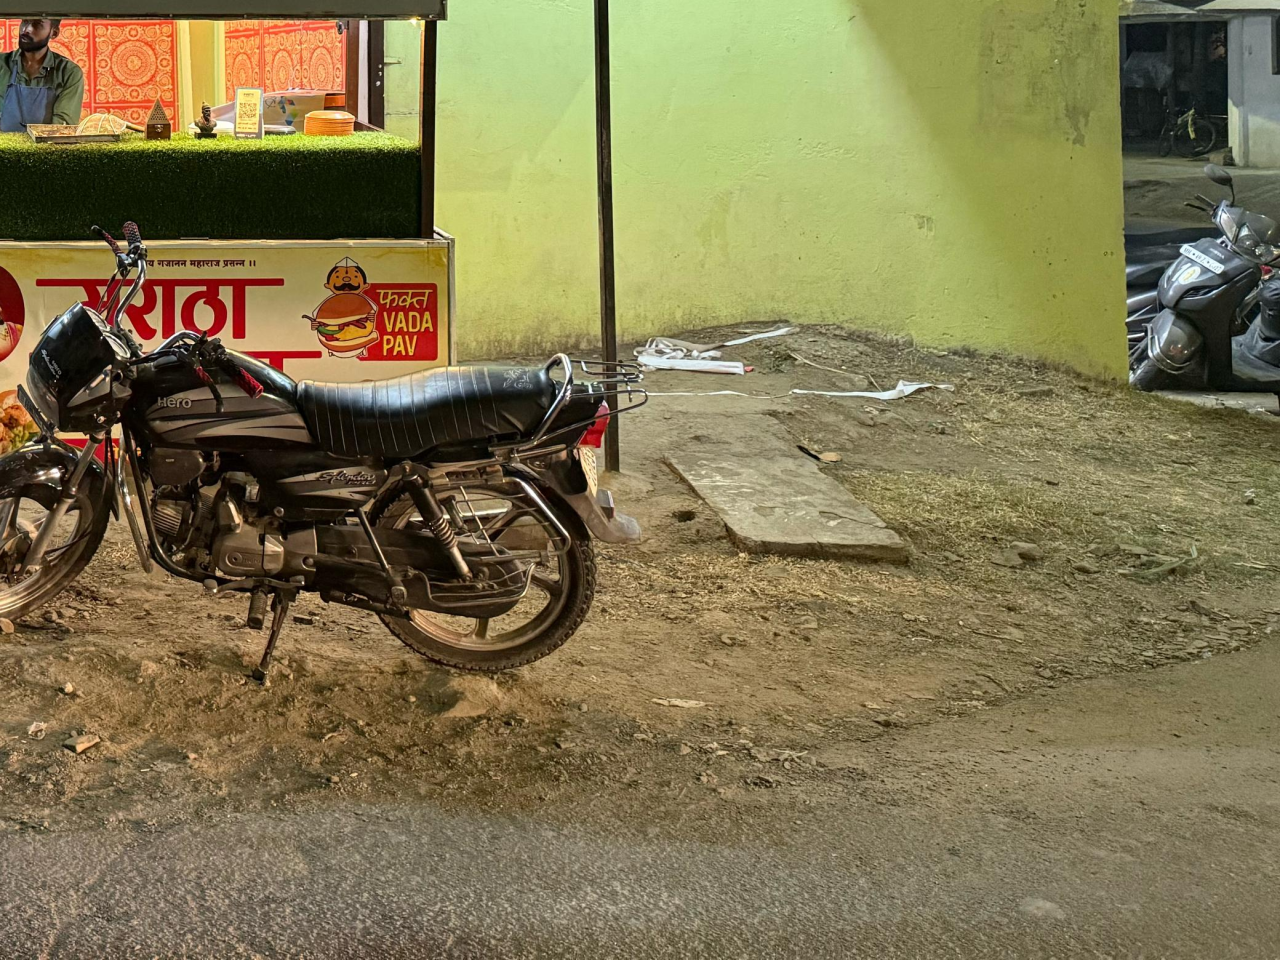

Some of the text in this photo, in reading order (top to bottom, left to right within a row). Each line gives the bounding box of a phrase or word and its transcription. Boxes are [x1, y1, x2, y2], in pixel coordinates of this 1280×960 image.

[157, 259, 187, 267] गजानन
[190, 259, 220, 269] महाराज
[222, 259, 245, 268] प्रसन्न
[383, 312, 434, 332] VADA
[382, 335, 416, 356] PAV
